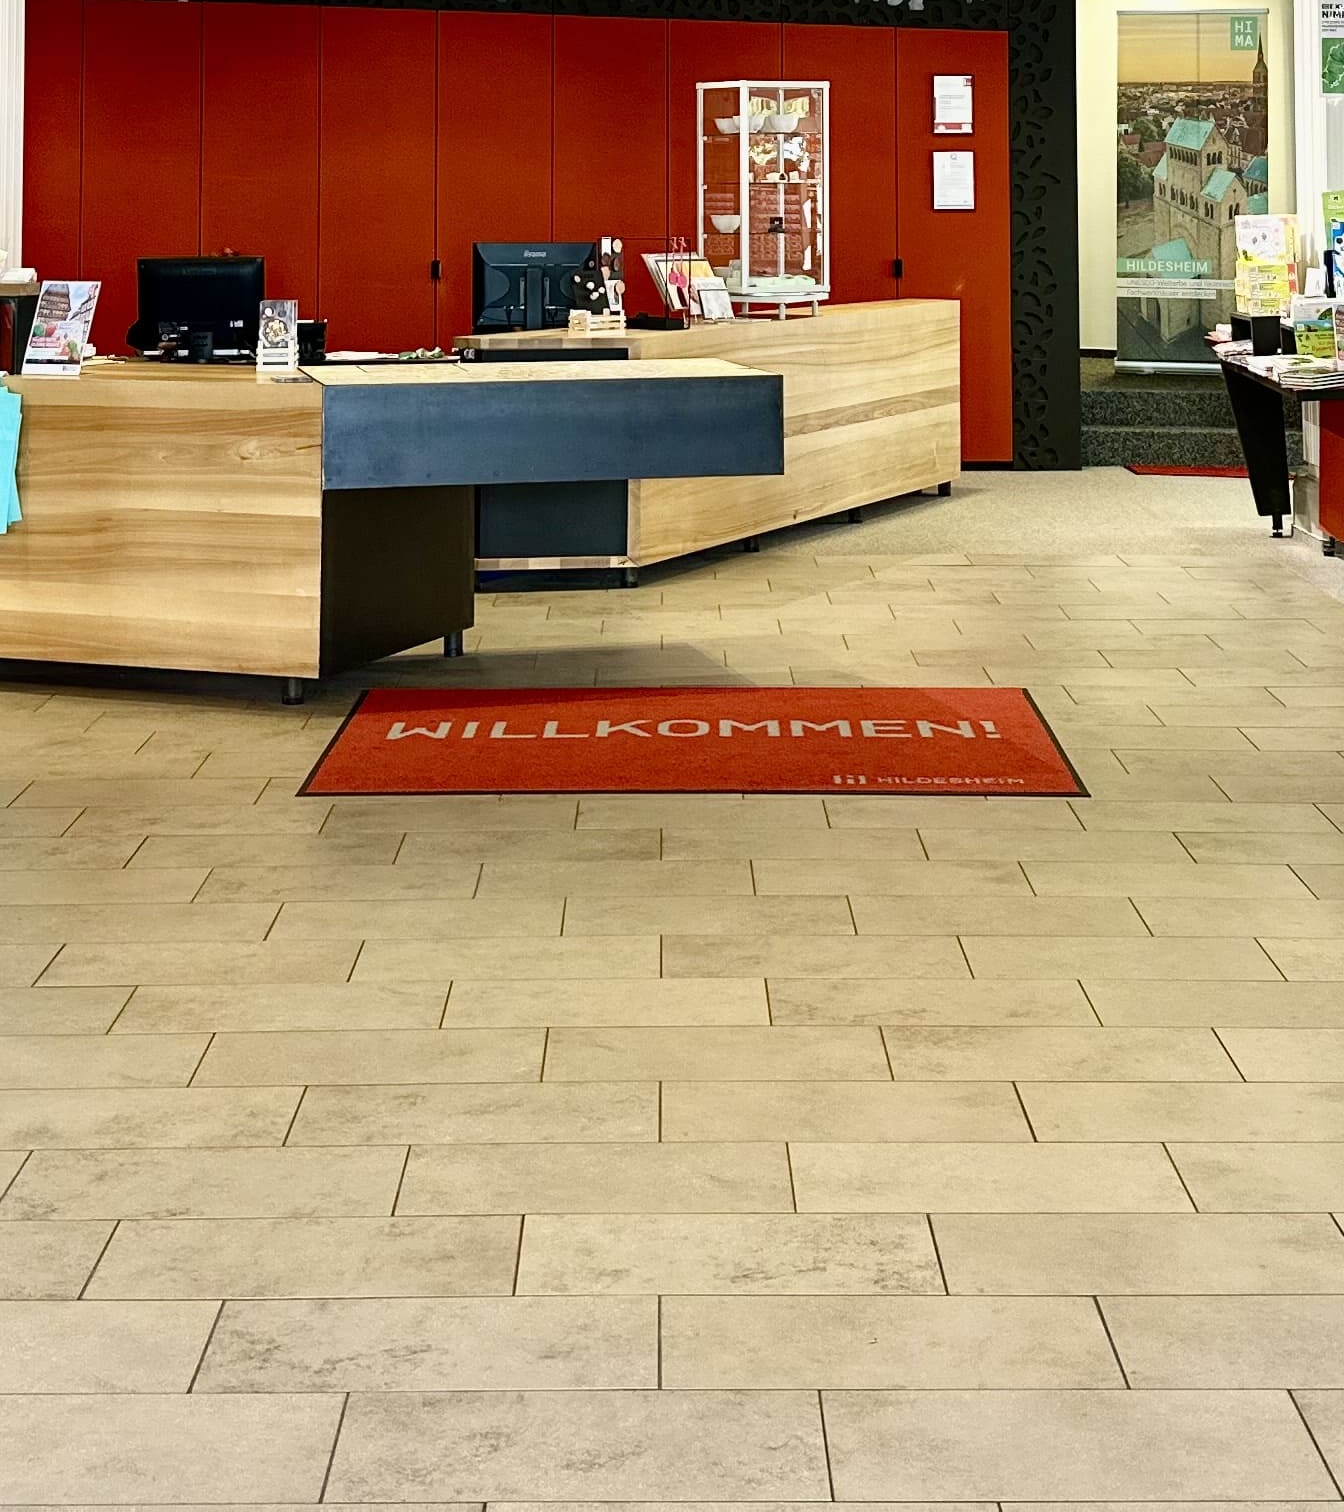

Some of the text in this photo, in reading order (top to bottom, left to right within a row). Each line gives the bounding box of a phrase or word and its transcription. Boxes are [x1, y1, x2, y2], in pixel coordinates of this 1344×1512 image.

[1234, 20, 1253, 33] HI
[1234, 34, 1254, 47] MA
[1126, 259, 1208, 273] HILDESHEIM
[385, 718, 1002, 740] WILLKOMMEN!
[877, 775, 1025, 785] HILDESHEIM
